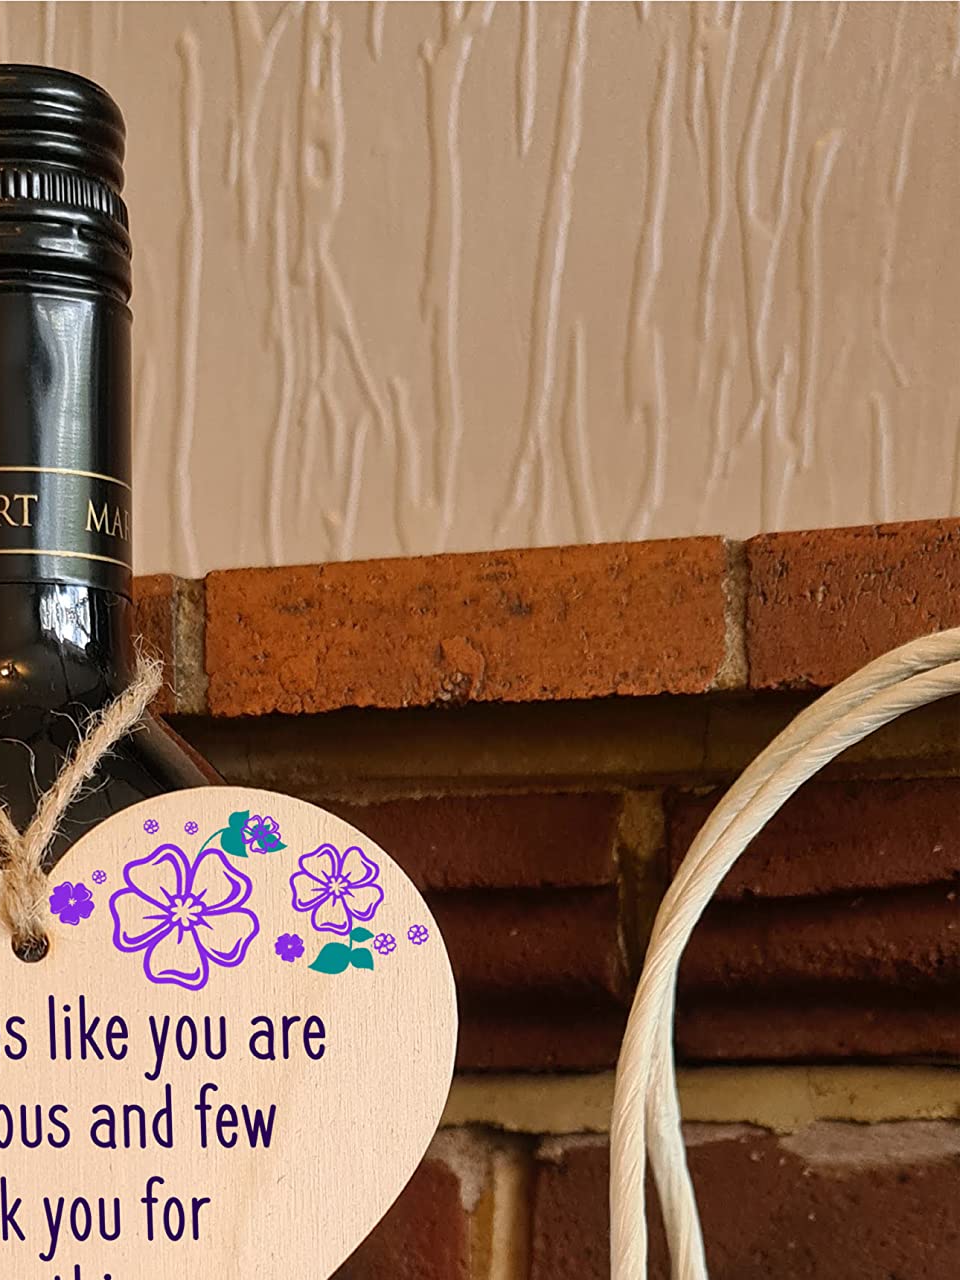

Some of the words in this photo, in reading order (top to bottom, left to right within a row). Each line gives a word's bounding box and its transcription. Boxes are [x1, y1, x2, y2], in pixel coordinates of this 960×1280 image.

[48, 994, 129, 1061] like
[144, 1014, 227, 1081] you
[248, 1014, 327, 1061] are
[90, 1083, 173, 1150] and
[194, 1082, 277, 1149] few
[38, 1196, 121, 1262] you
[140, 1175, 211, 1242] for
